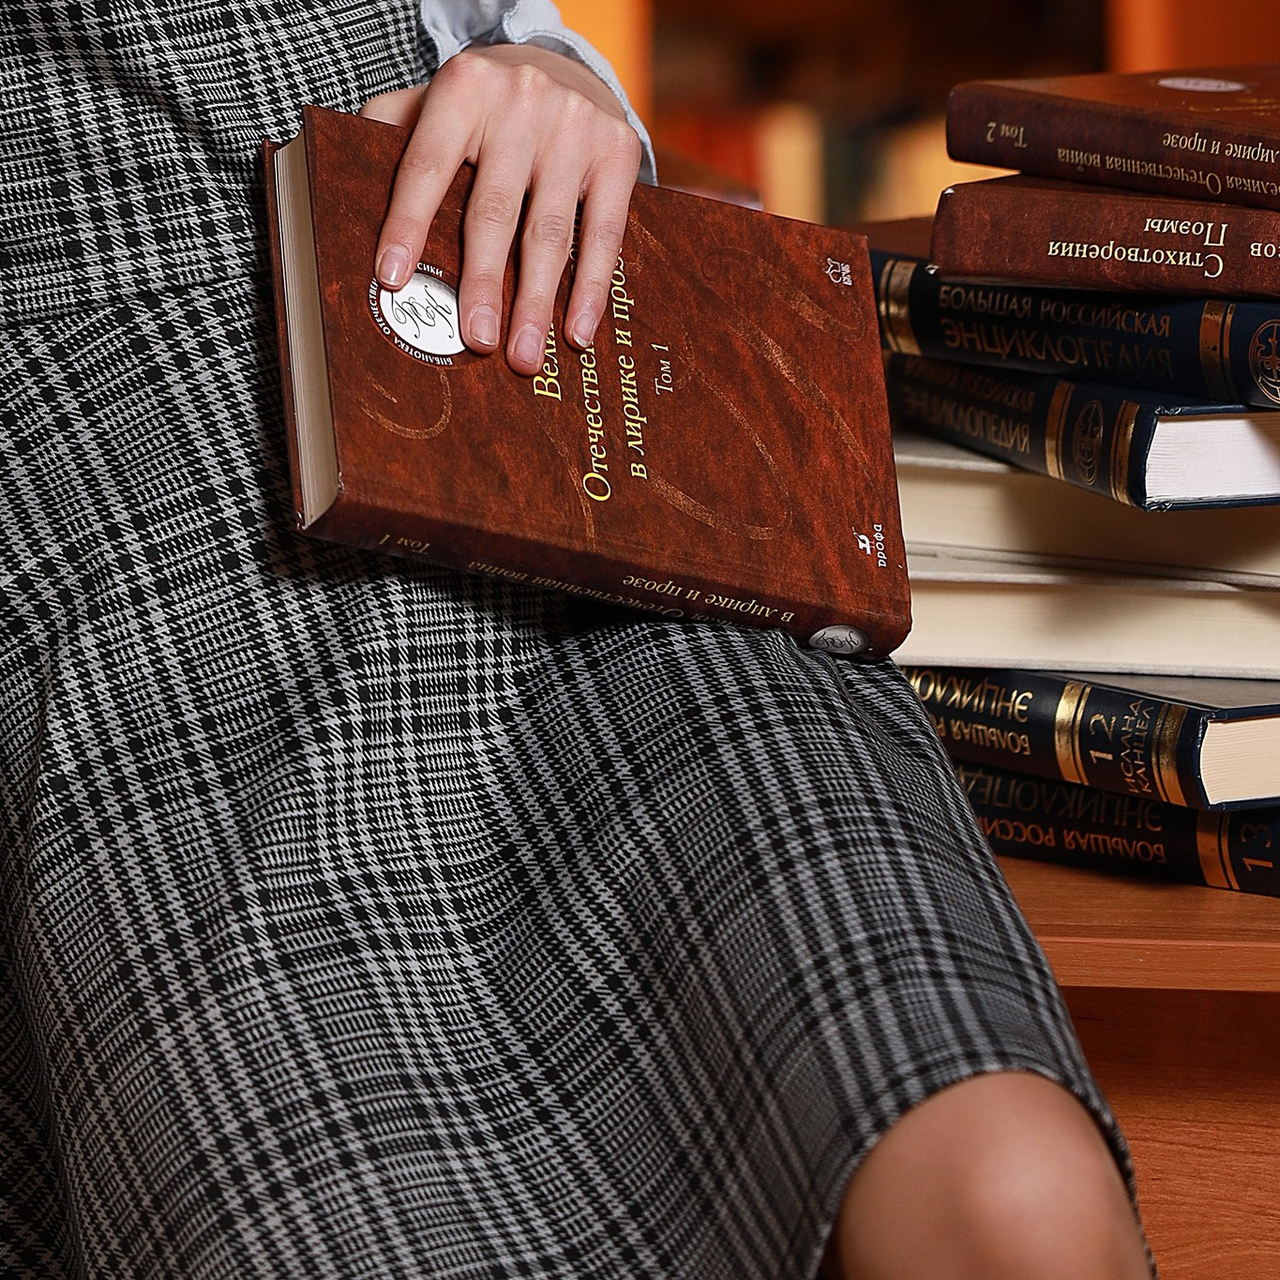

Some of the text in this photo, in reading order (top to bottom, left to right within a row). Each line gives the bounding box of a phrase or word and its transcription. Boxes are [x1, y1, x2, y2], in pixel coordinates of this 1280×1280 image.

[985, 121, 1027, 148] Том 2
[1162, 131, 1280, 164] лирике и прозе
[1057, 147, 1101, 172] война
[1104, 154, 1222, 196] Отечественная
[1143, 218, 1229, 247] Поэмы
[1047, 241, 1224, 278] Стихотворения
[368, 276, 454, 366] БИБЛИОТЕКА ОТЕЧЕСТВЕН
[938, 285, 1172, 340] БОЛЬШАЯ РОССИЙСКАЯ
[615, 327, 633, 347] и
[939, 317, 1175, 379] ЭНЦИКЛОПЕДИЯ
[533, 322, 562, 402] Вели
[651, 342, 674, 396] Том 1
[618, 353, 648, 457] лирике
[630, 462, 648, 480] в
[397, 536, 431, 555] Том
[531, 575, 685, 618] Отечественная
[622, 575, 683, 598] прозе
[685, 588, 702, 601] и
[704, 592, 779, 619] лирике
[951, 718, 1031, 756] БОЛЬШАЯ
[1089, 712, 1117, 765] 12
[1131, 706, 1155, 793] КАНЦЕЛ
[956, 766, 1163, 833] ЭНЦИКЛОПЕД
[977, 816, 1167, 865] БОЛЬШАЯ РОССИ
[1240, 822, 1275, 872] 13
